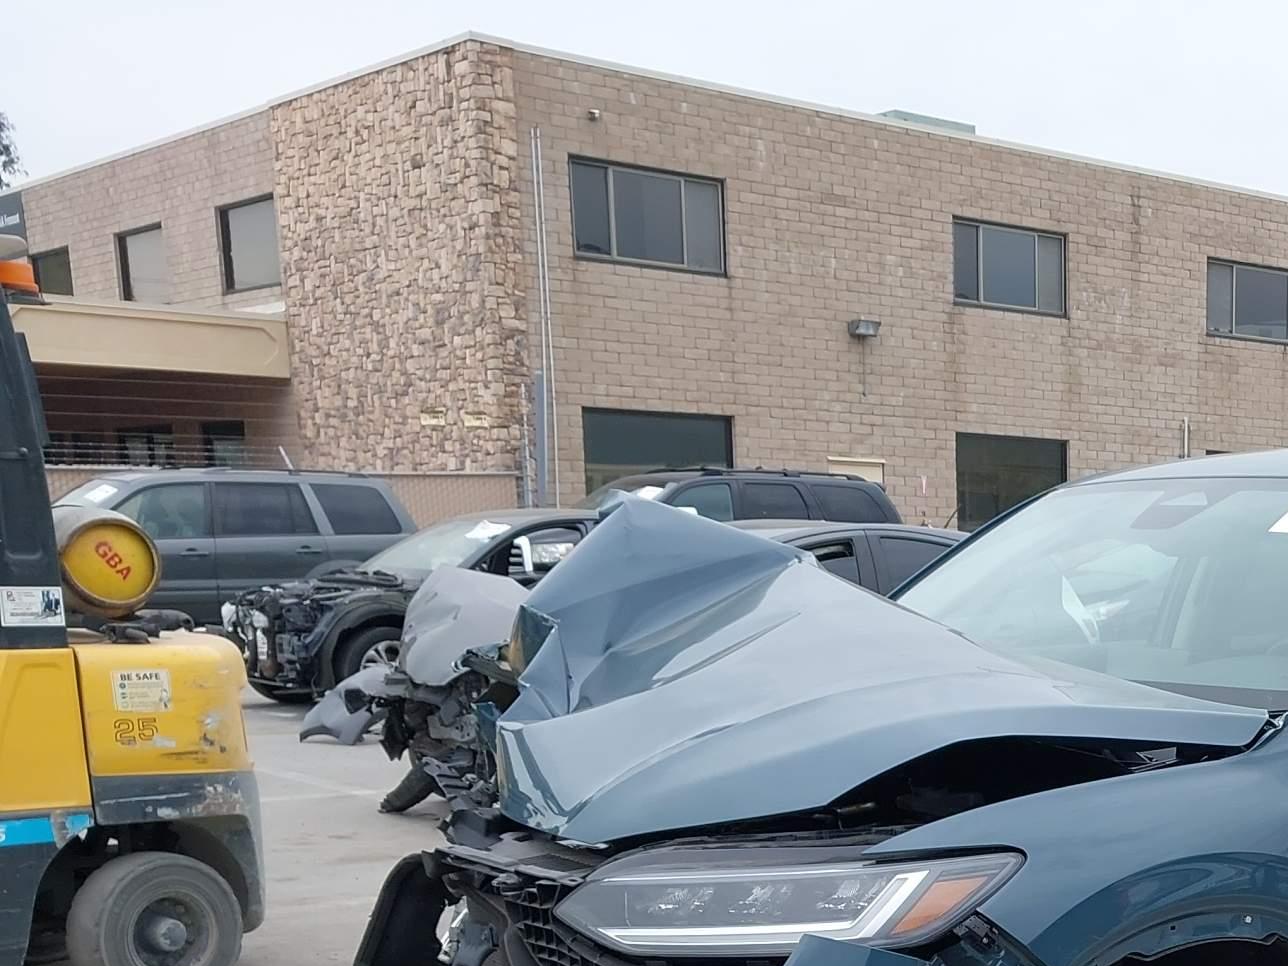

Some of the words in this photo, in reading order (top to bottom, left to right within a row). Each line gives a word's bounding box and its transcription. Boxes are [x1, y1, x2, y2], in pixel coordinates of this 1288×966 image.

[95, 541, 131, 581] GBA
[120, 673, 132, 681] BE
[136, 672, 160, 681] SAFE
[113, 717, 159, 745] 25
